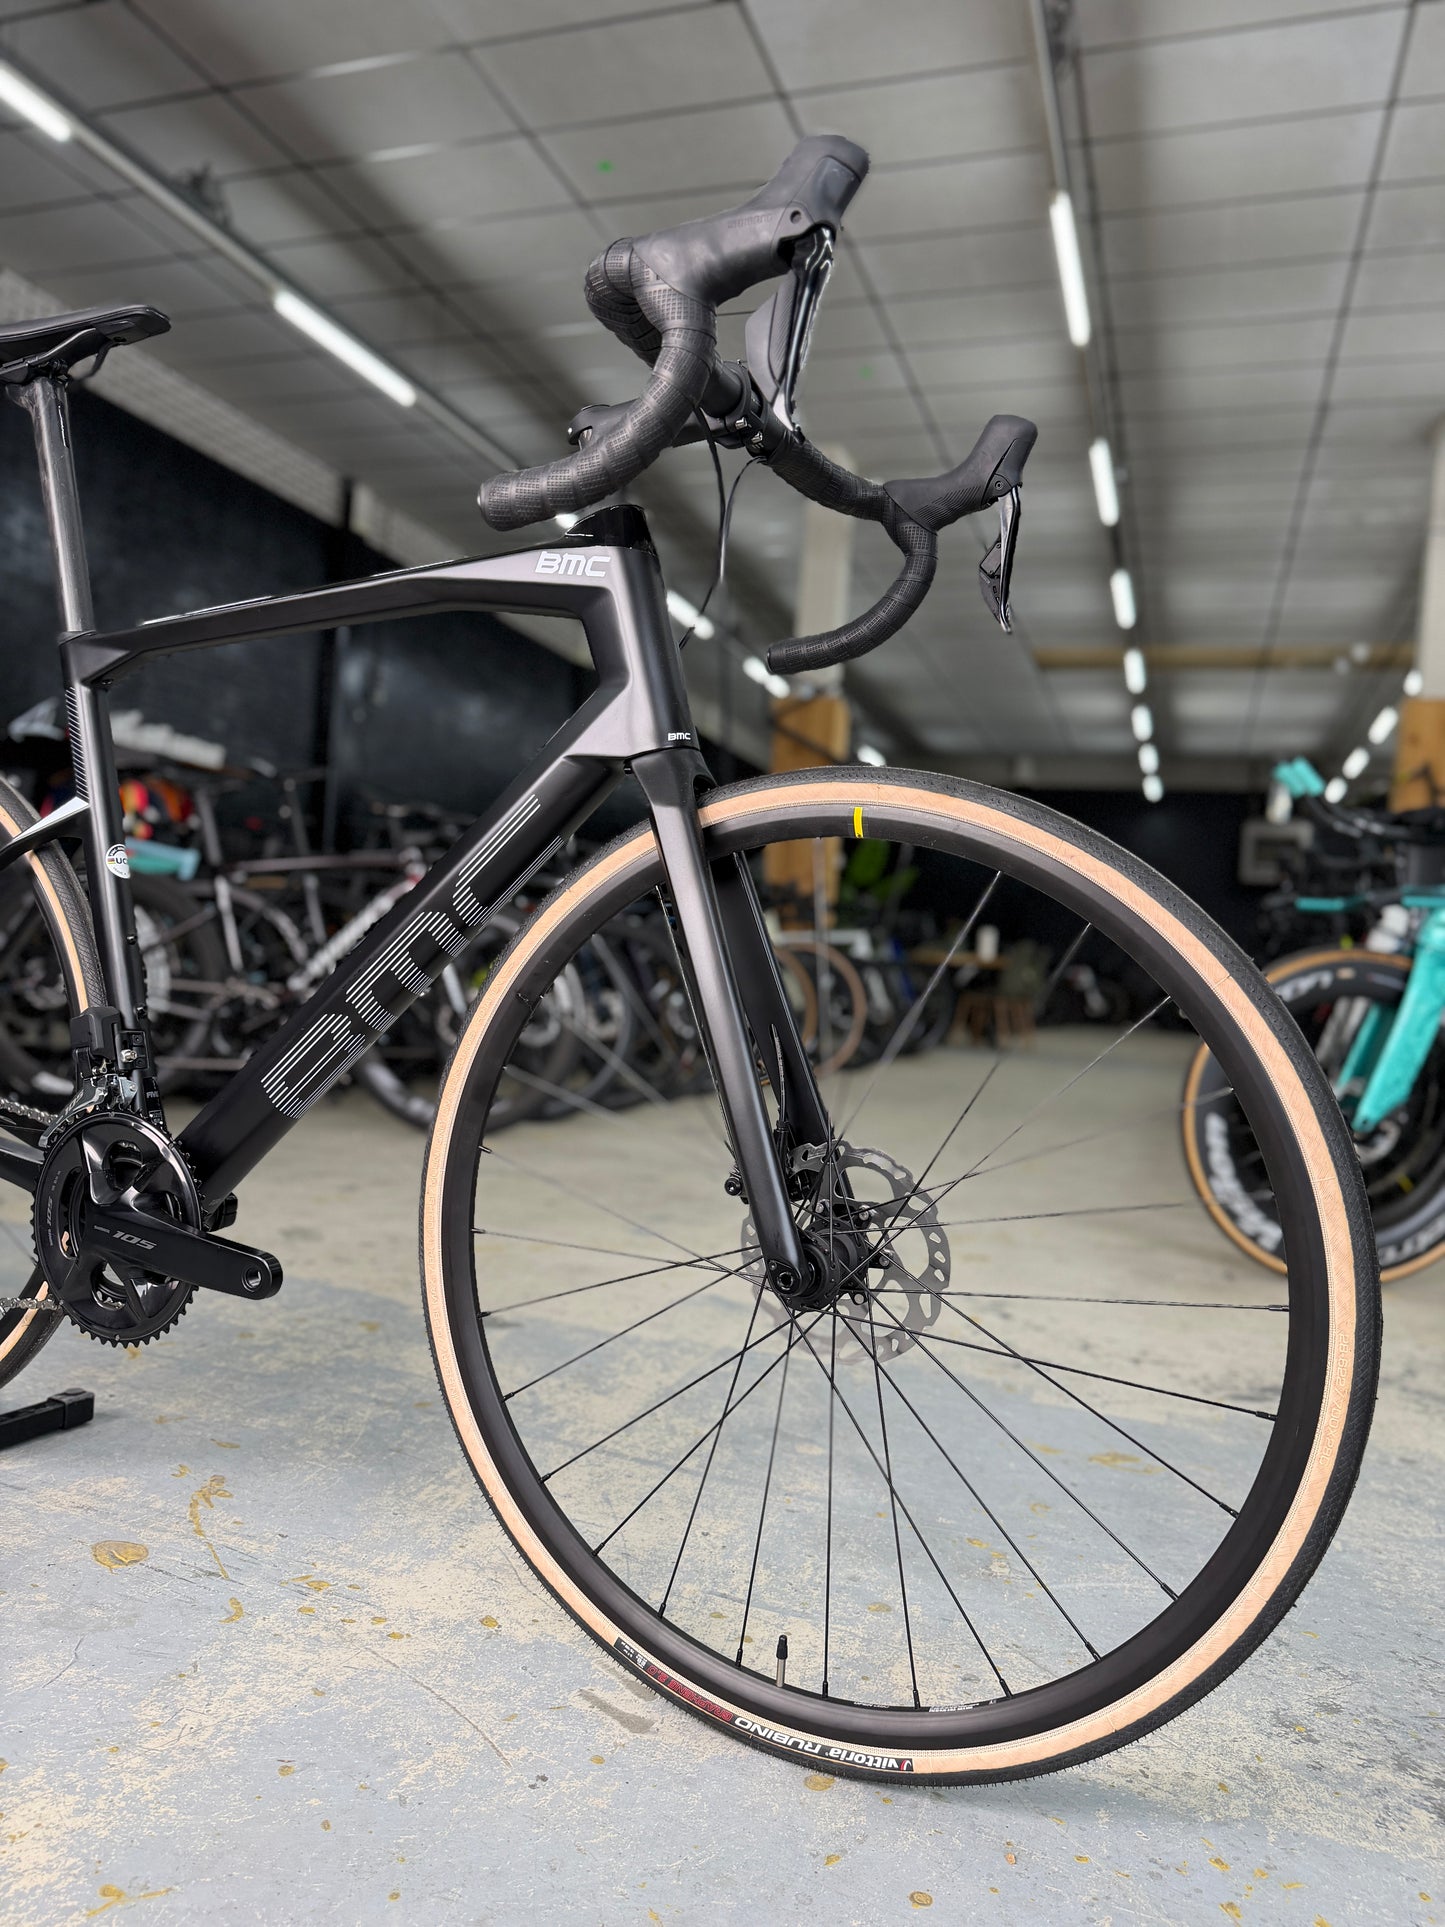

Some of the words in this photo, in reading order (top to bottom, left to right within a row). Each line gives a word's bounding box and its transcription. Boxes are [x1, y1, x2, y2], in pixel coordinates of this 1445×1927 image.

[535, 551, 611, 577] BMC
[668, 732, 691, 741] BMC
[261, 794, 565, 1120] BMC
[112, 1230, 158, 1250] 105
[735, 1717, 824, 1753] RUBINO
[829, 1747, 899, 1769] vittoria
